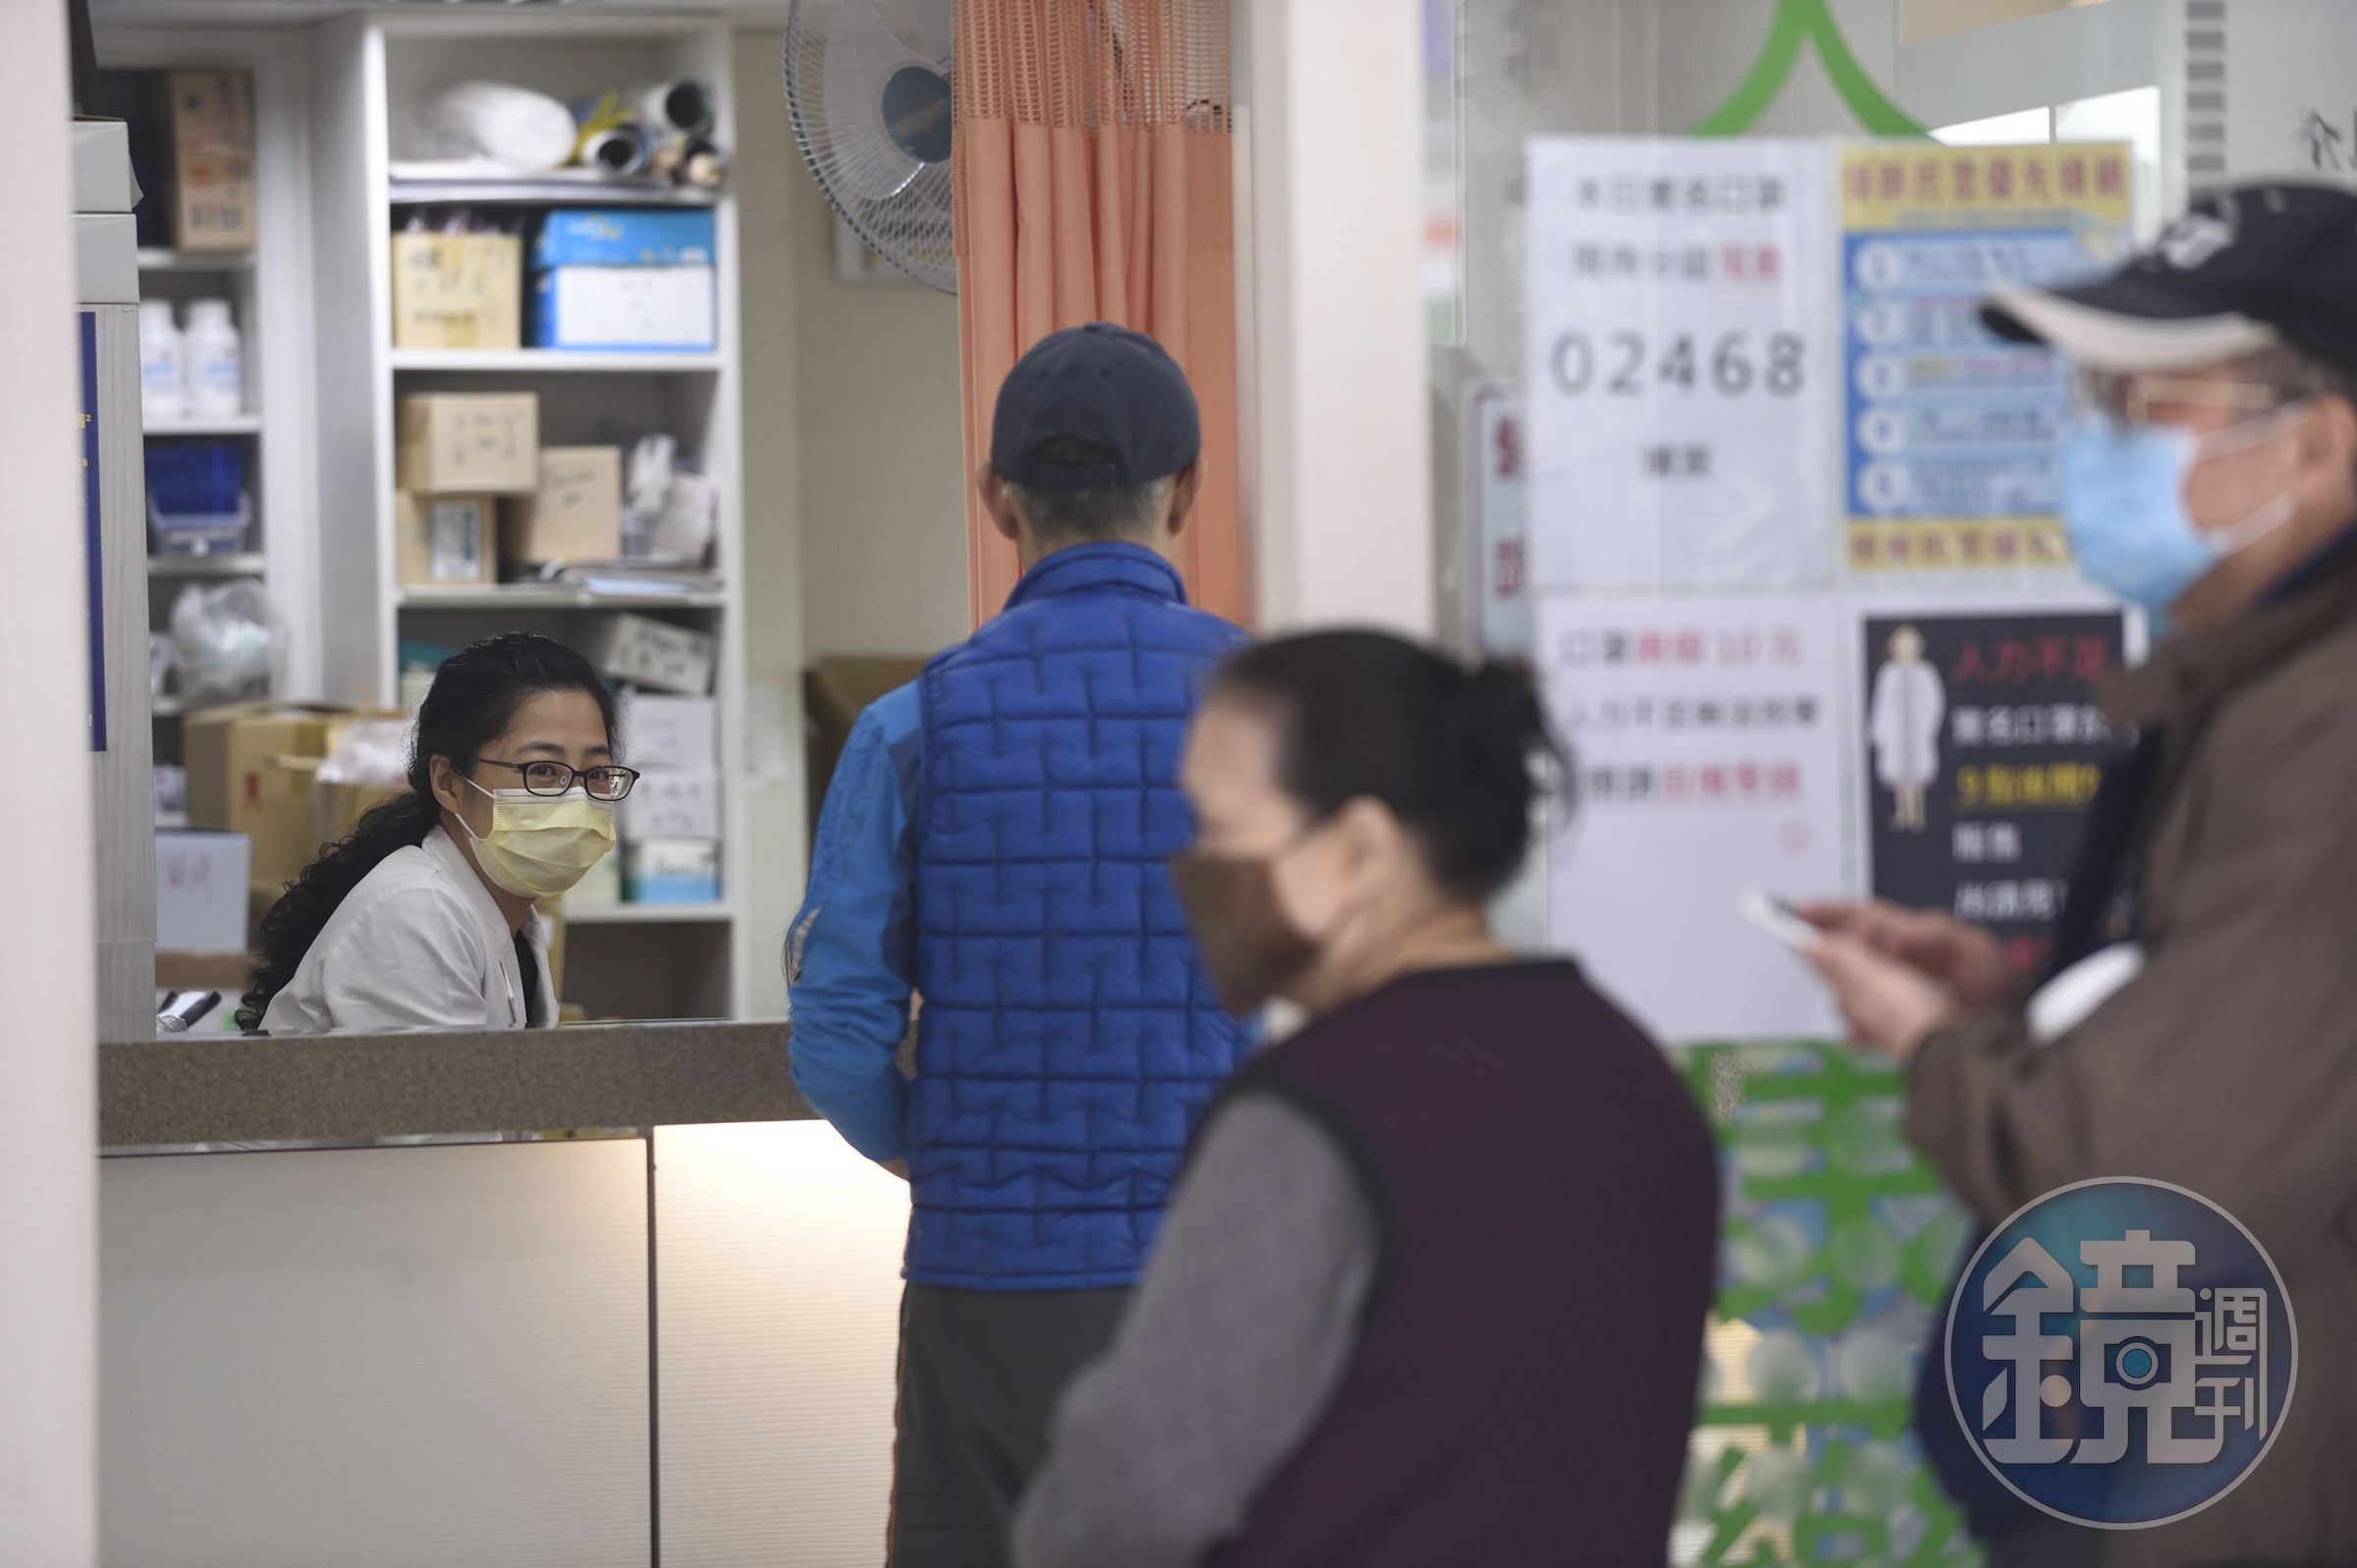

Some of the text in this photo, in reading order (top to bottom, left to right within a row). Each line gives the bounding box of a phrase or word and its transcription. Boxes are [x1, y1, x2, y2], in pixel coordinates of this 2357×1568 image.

[1550, 330, 1807, 398] 02468
[1953, 880, 2070, 923] 尚請見
